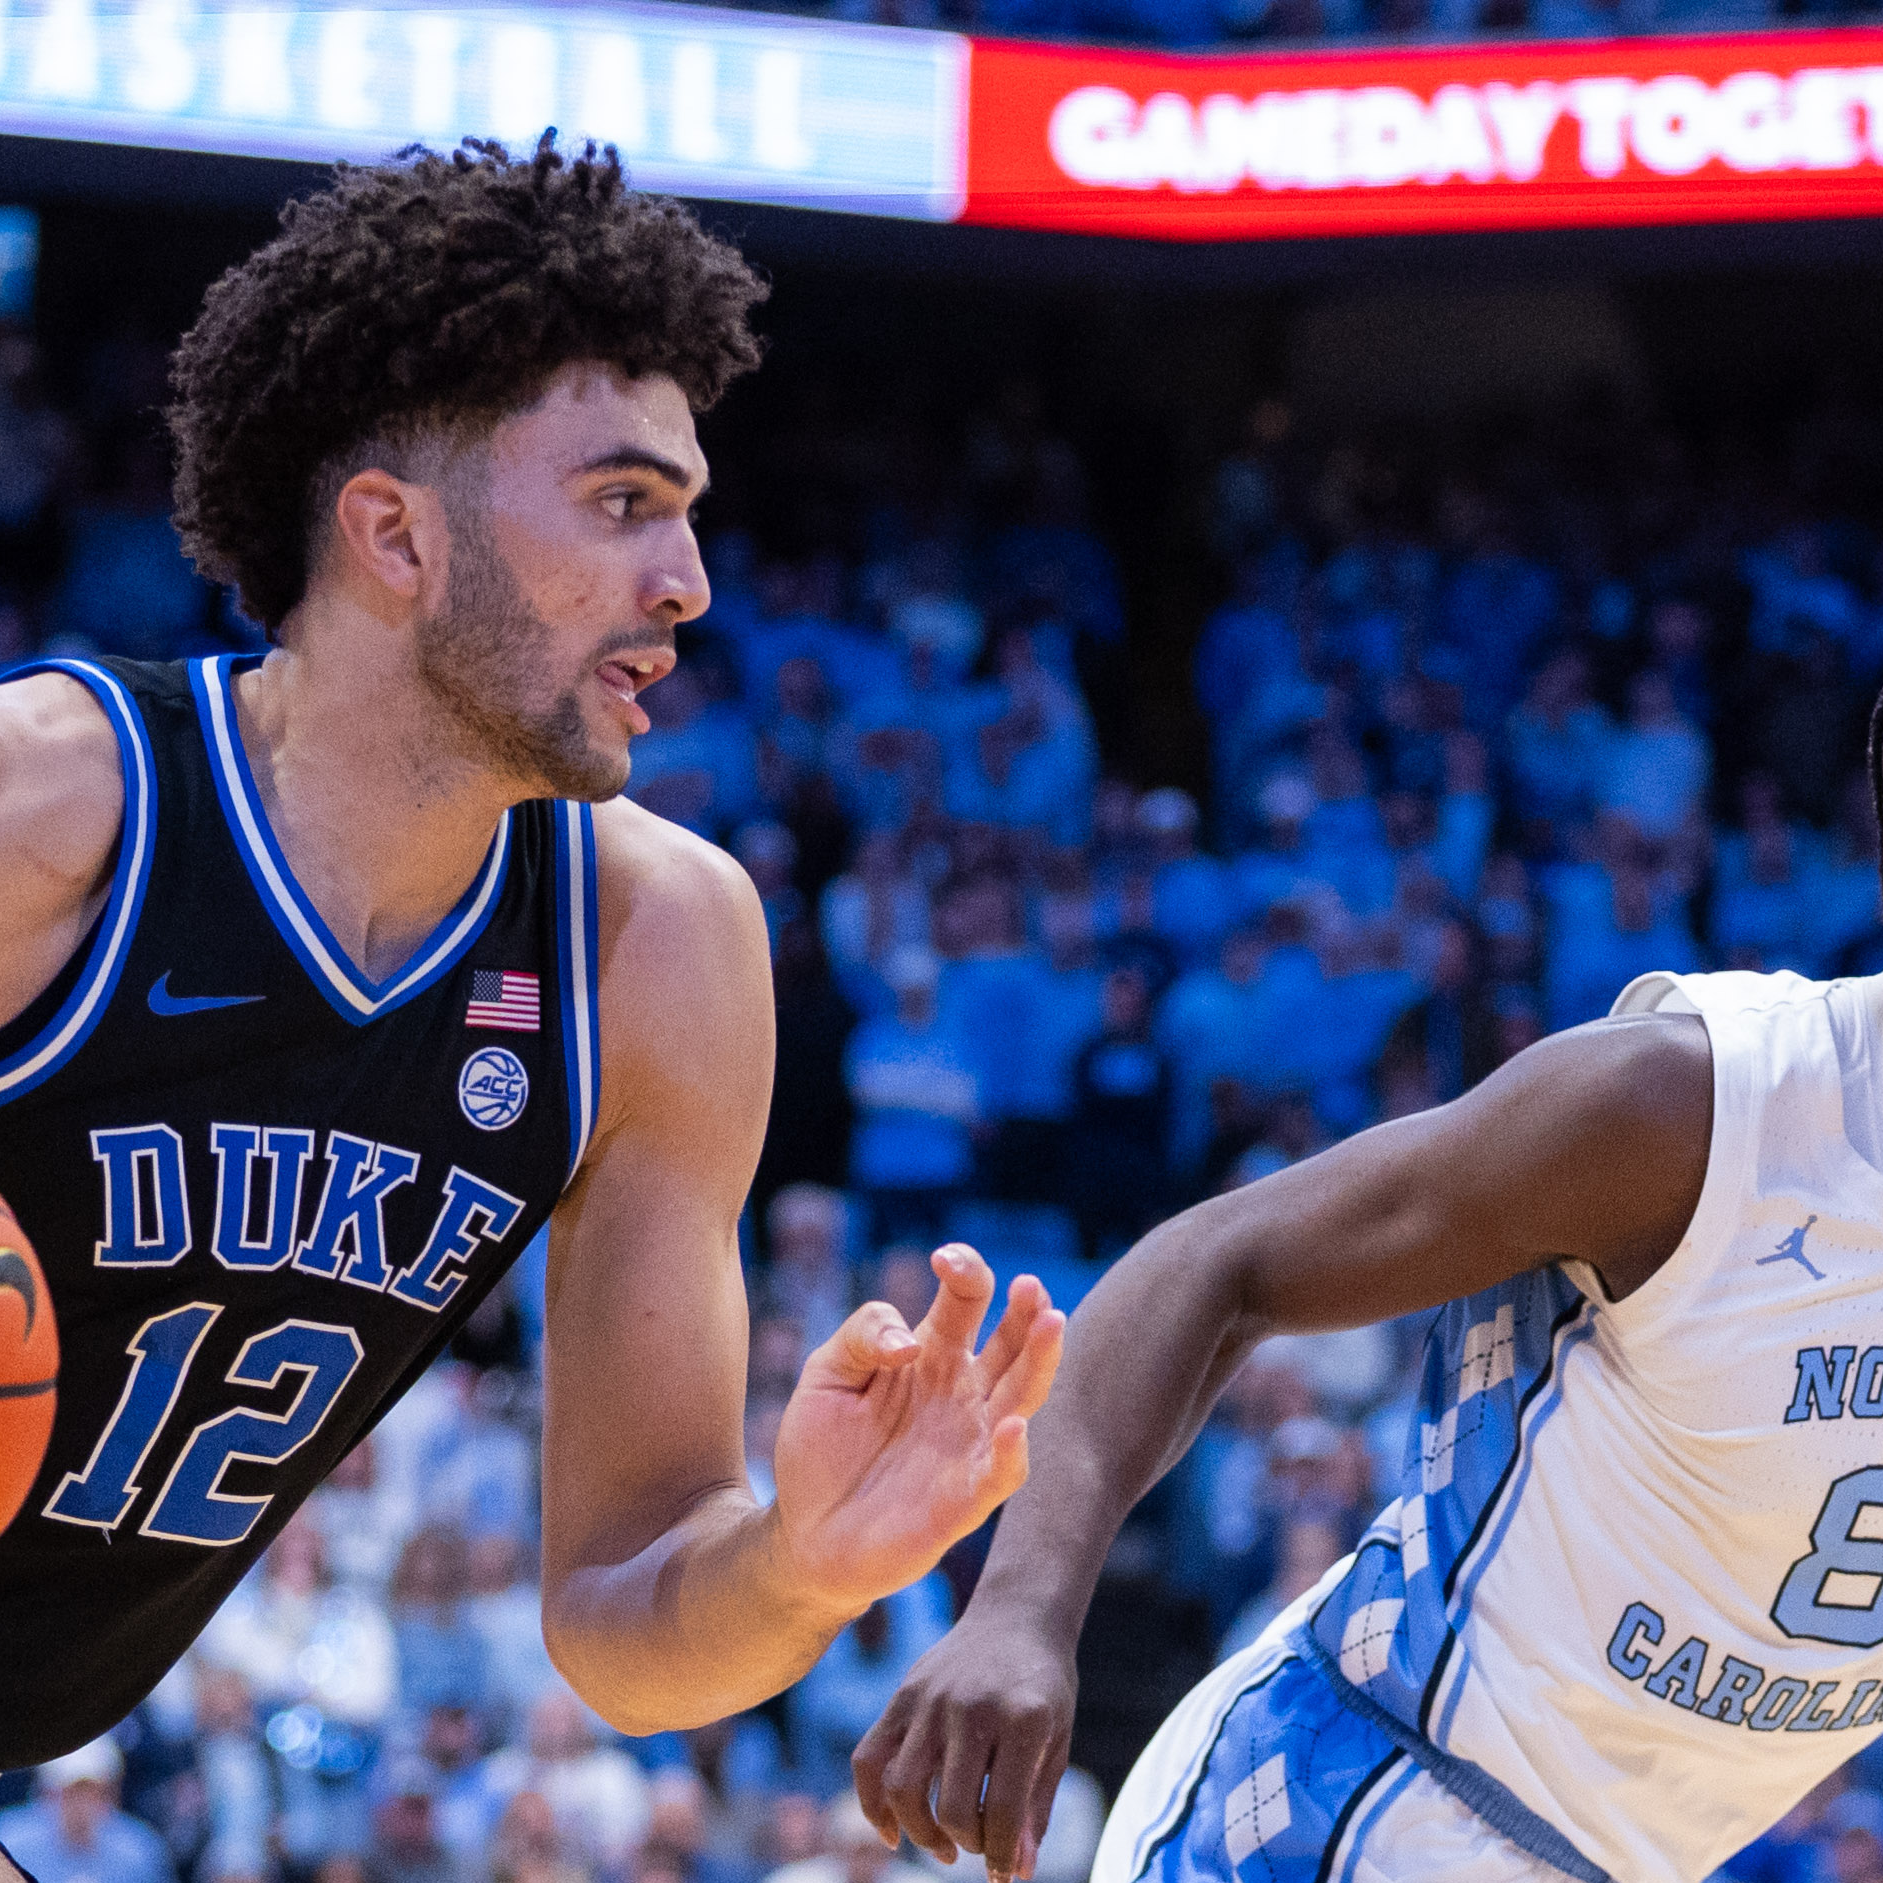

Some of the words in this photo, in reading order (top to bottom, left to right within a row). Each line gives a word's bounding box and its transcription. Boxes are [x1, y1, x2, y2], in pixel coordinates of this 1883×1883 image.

[469, 1074, 525, 1101] ACC
[89, 1122, 526, 1312] DUKE
[41, 1301, 365, 1546] 12
